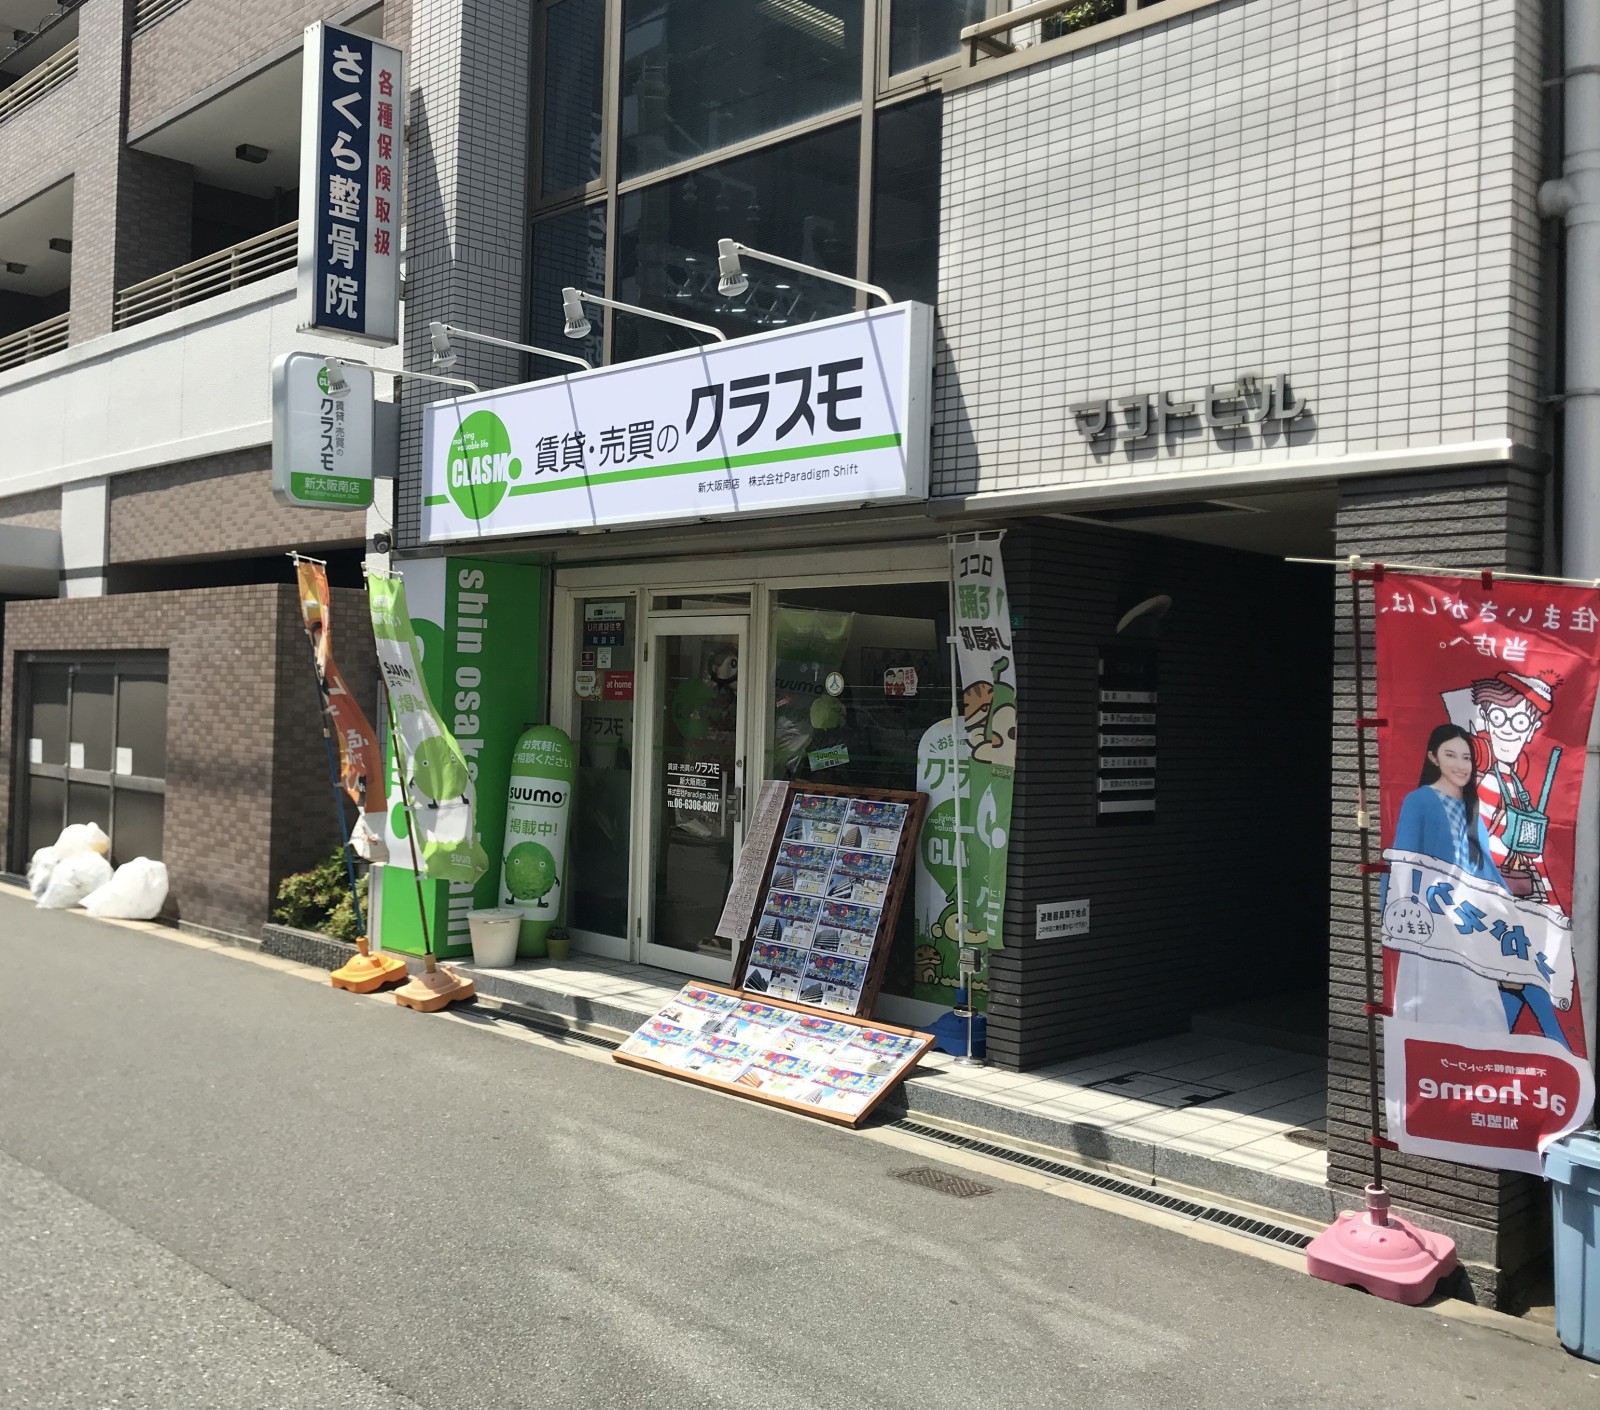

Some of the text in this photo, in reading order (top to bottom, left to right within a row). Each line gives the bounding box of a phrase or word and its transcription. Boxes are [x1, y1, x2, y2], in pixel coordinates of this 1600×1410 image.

[374, 69, 394, 257] 各種保険取扱
[326, 45, 363, 319] さくら整骨院
[1069, 373, 1306, 441] マコトビル
[320, 398, 334, 472] クラスモ
[304, 476, 360, 494] 新大阪南店
[698, 463, 859, 494] 新大阪南店 株式会社Paradigm Shift
[960, 554, 993, 578] ココロ
[457, 568, 489, 654] shin
[523, 740, 562, 753] お気軽に
[512, 753, 573, 768] ご相談ください
[706, 792, 719, 801] Shift
[510, 818, 558, 837] 掲載中!
